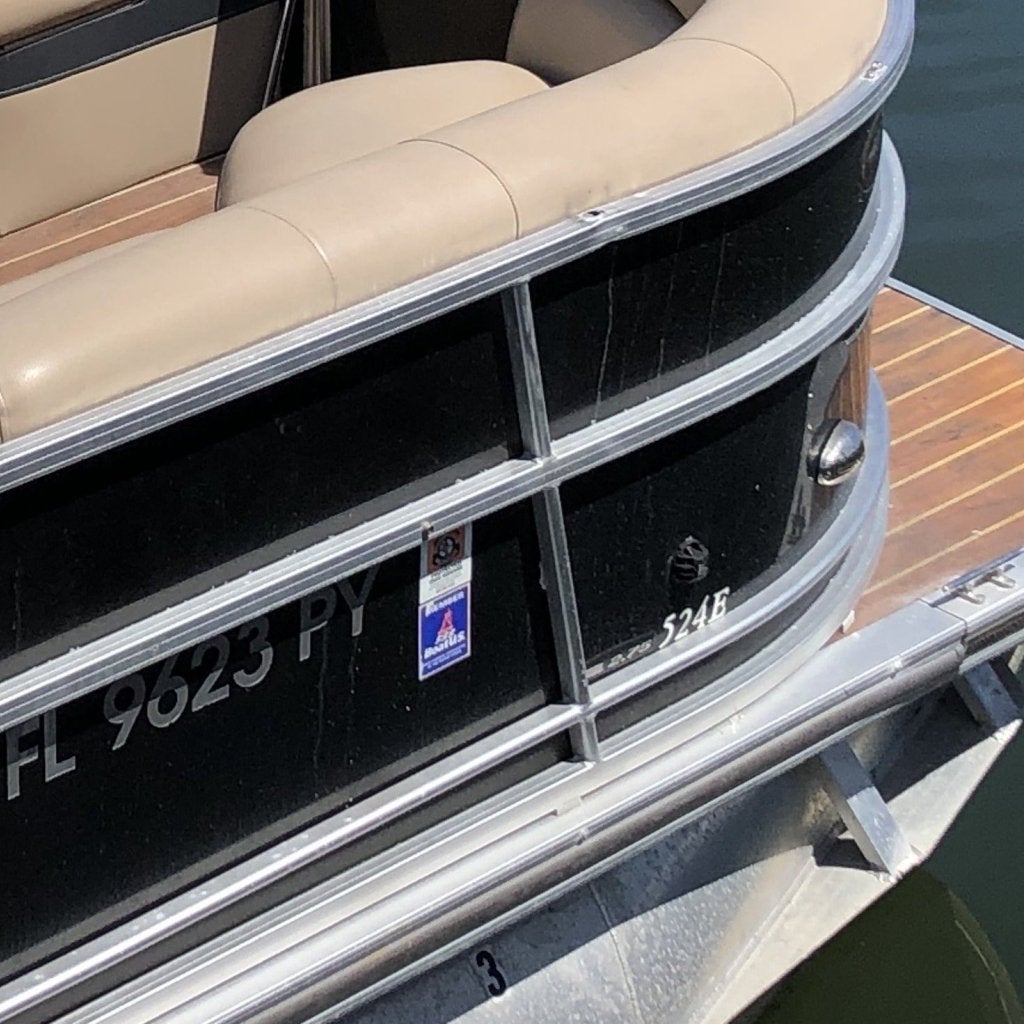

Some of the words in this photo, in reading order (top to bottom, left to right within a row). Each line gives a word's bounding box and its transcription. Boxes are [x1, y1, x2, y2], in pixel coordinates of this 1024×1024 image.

[659, 586, 731, 649] 524E
[5, 708, 76, 801] FL
[102, 613, 275, 751] 9623
[298, 564, 378, 662] PY
[476, 950, 507, 997] 3
